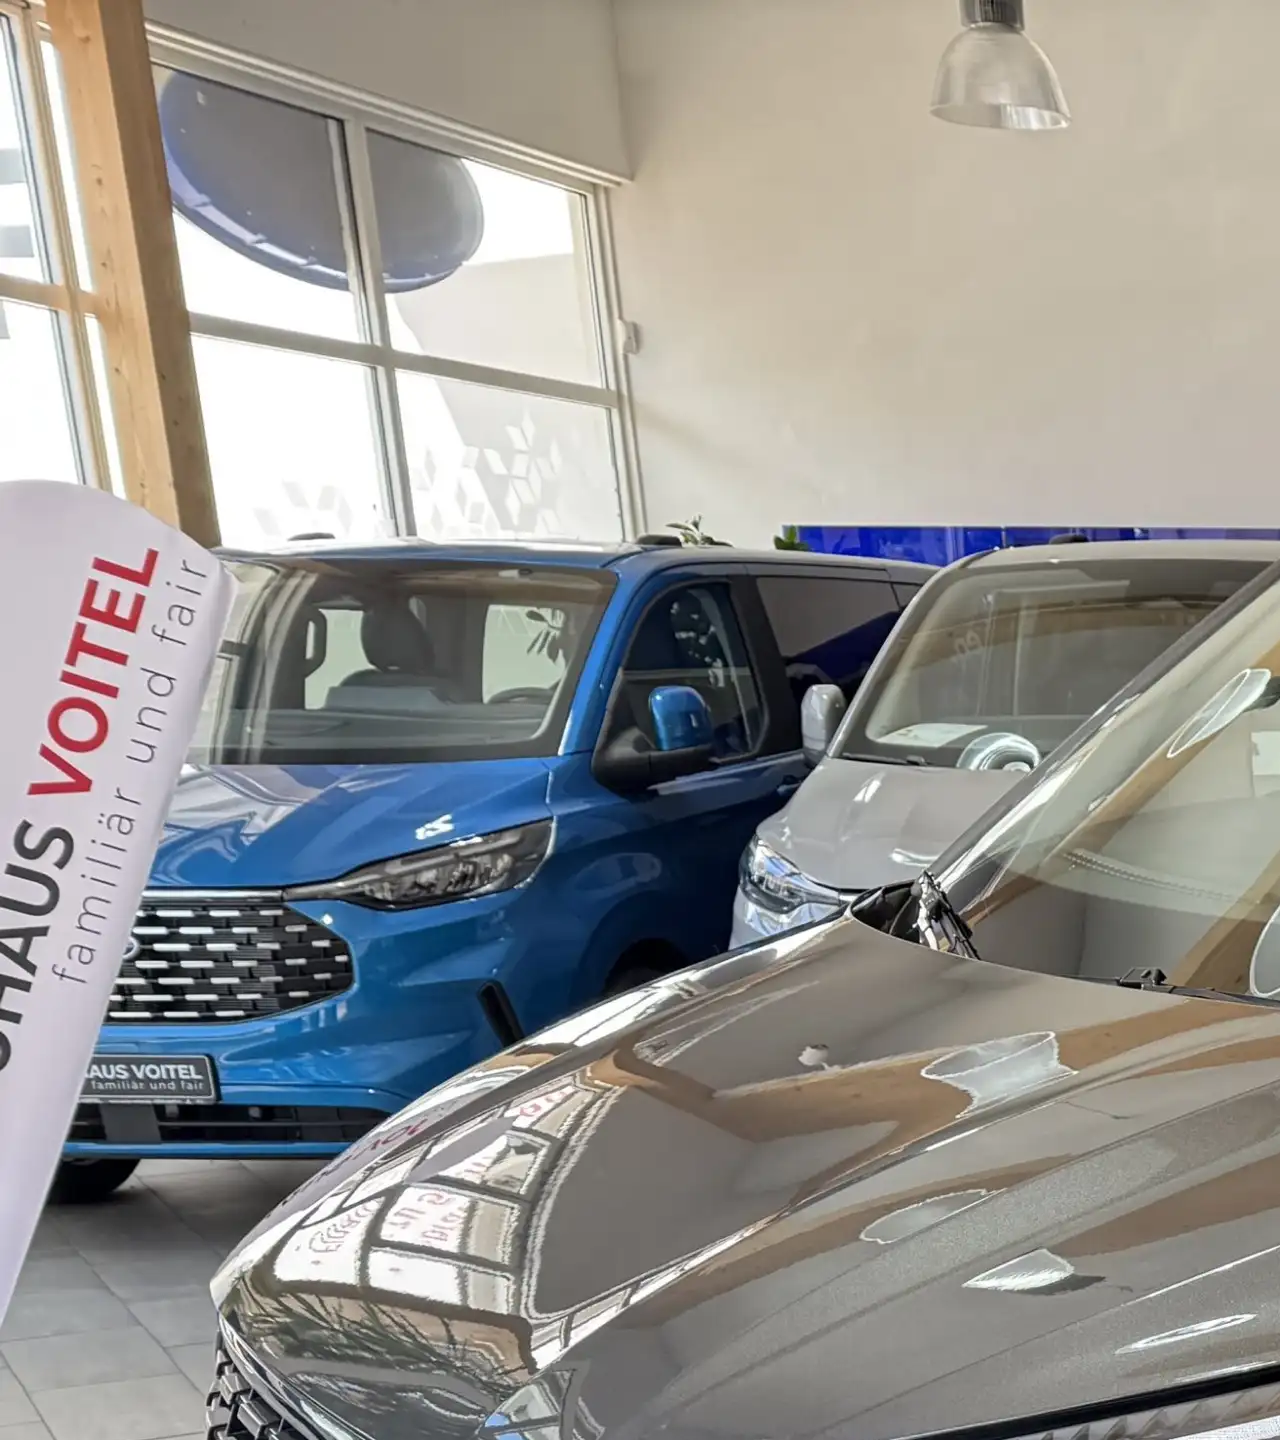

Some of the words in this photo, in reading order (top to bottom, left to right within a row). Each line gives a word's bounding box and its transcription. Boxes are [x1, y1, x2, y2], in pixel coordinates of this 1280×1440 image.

[151, 558, 207, 646] fair
[28, 548, 160, 798] VOITEL
[126, 668, 177, 766] und
[51, 787, 140, 984] familiär
[130, 1064, 203, 1080] VOITEL
[150, 1081, 176, 1091] und
[180, 1081, 204, 1091] fair
